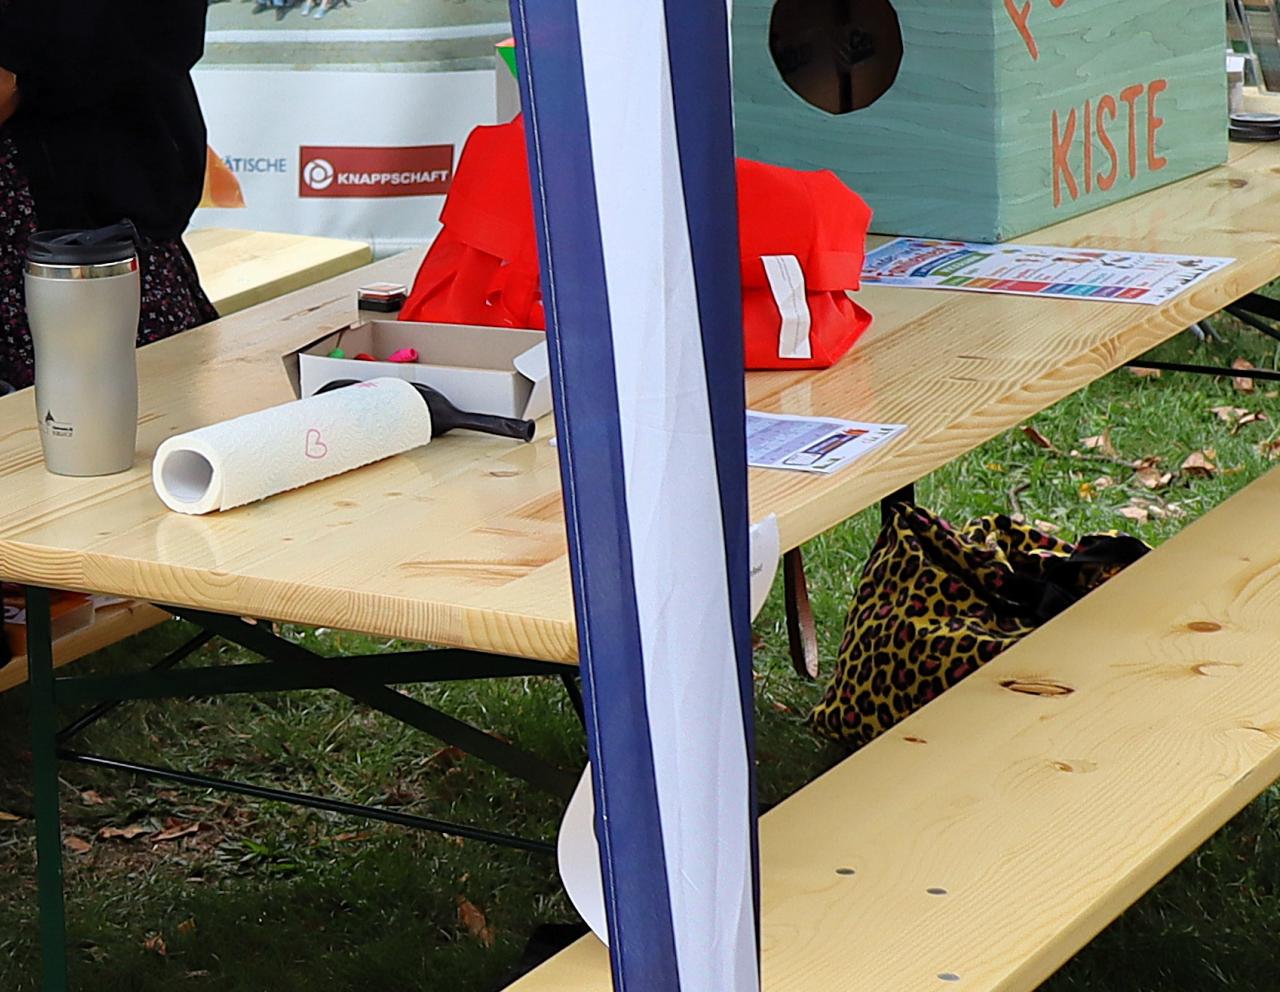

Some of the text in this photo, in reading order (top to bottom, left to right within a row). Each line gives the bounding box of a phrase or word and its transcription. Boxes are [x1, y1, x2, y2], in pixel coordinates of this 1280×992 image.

[1052, 78, 1168, 207] KISTE
[223, 155, 288, 173] ÄTISCHE
[336, 169, 450, 186] KNAPPSCHAFT
